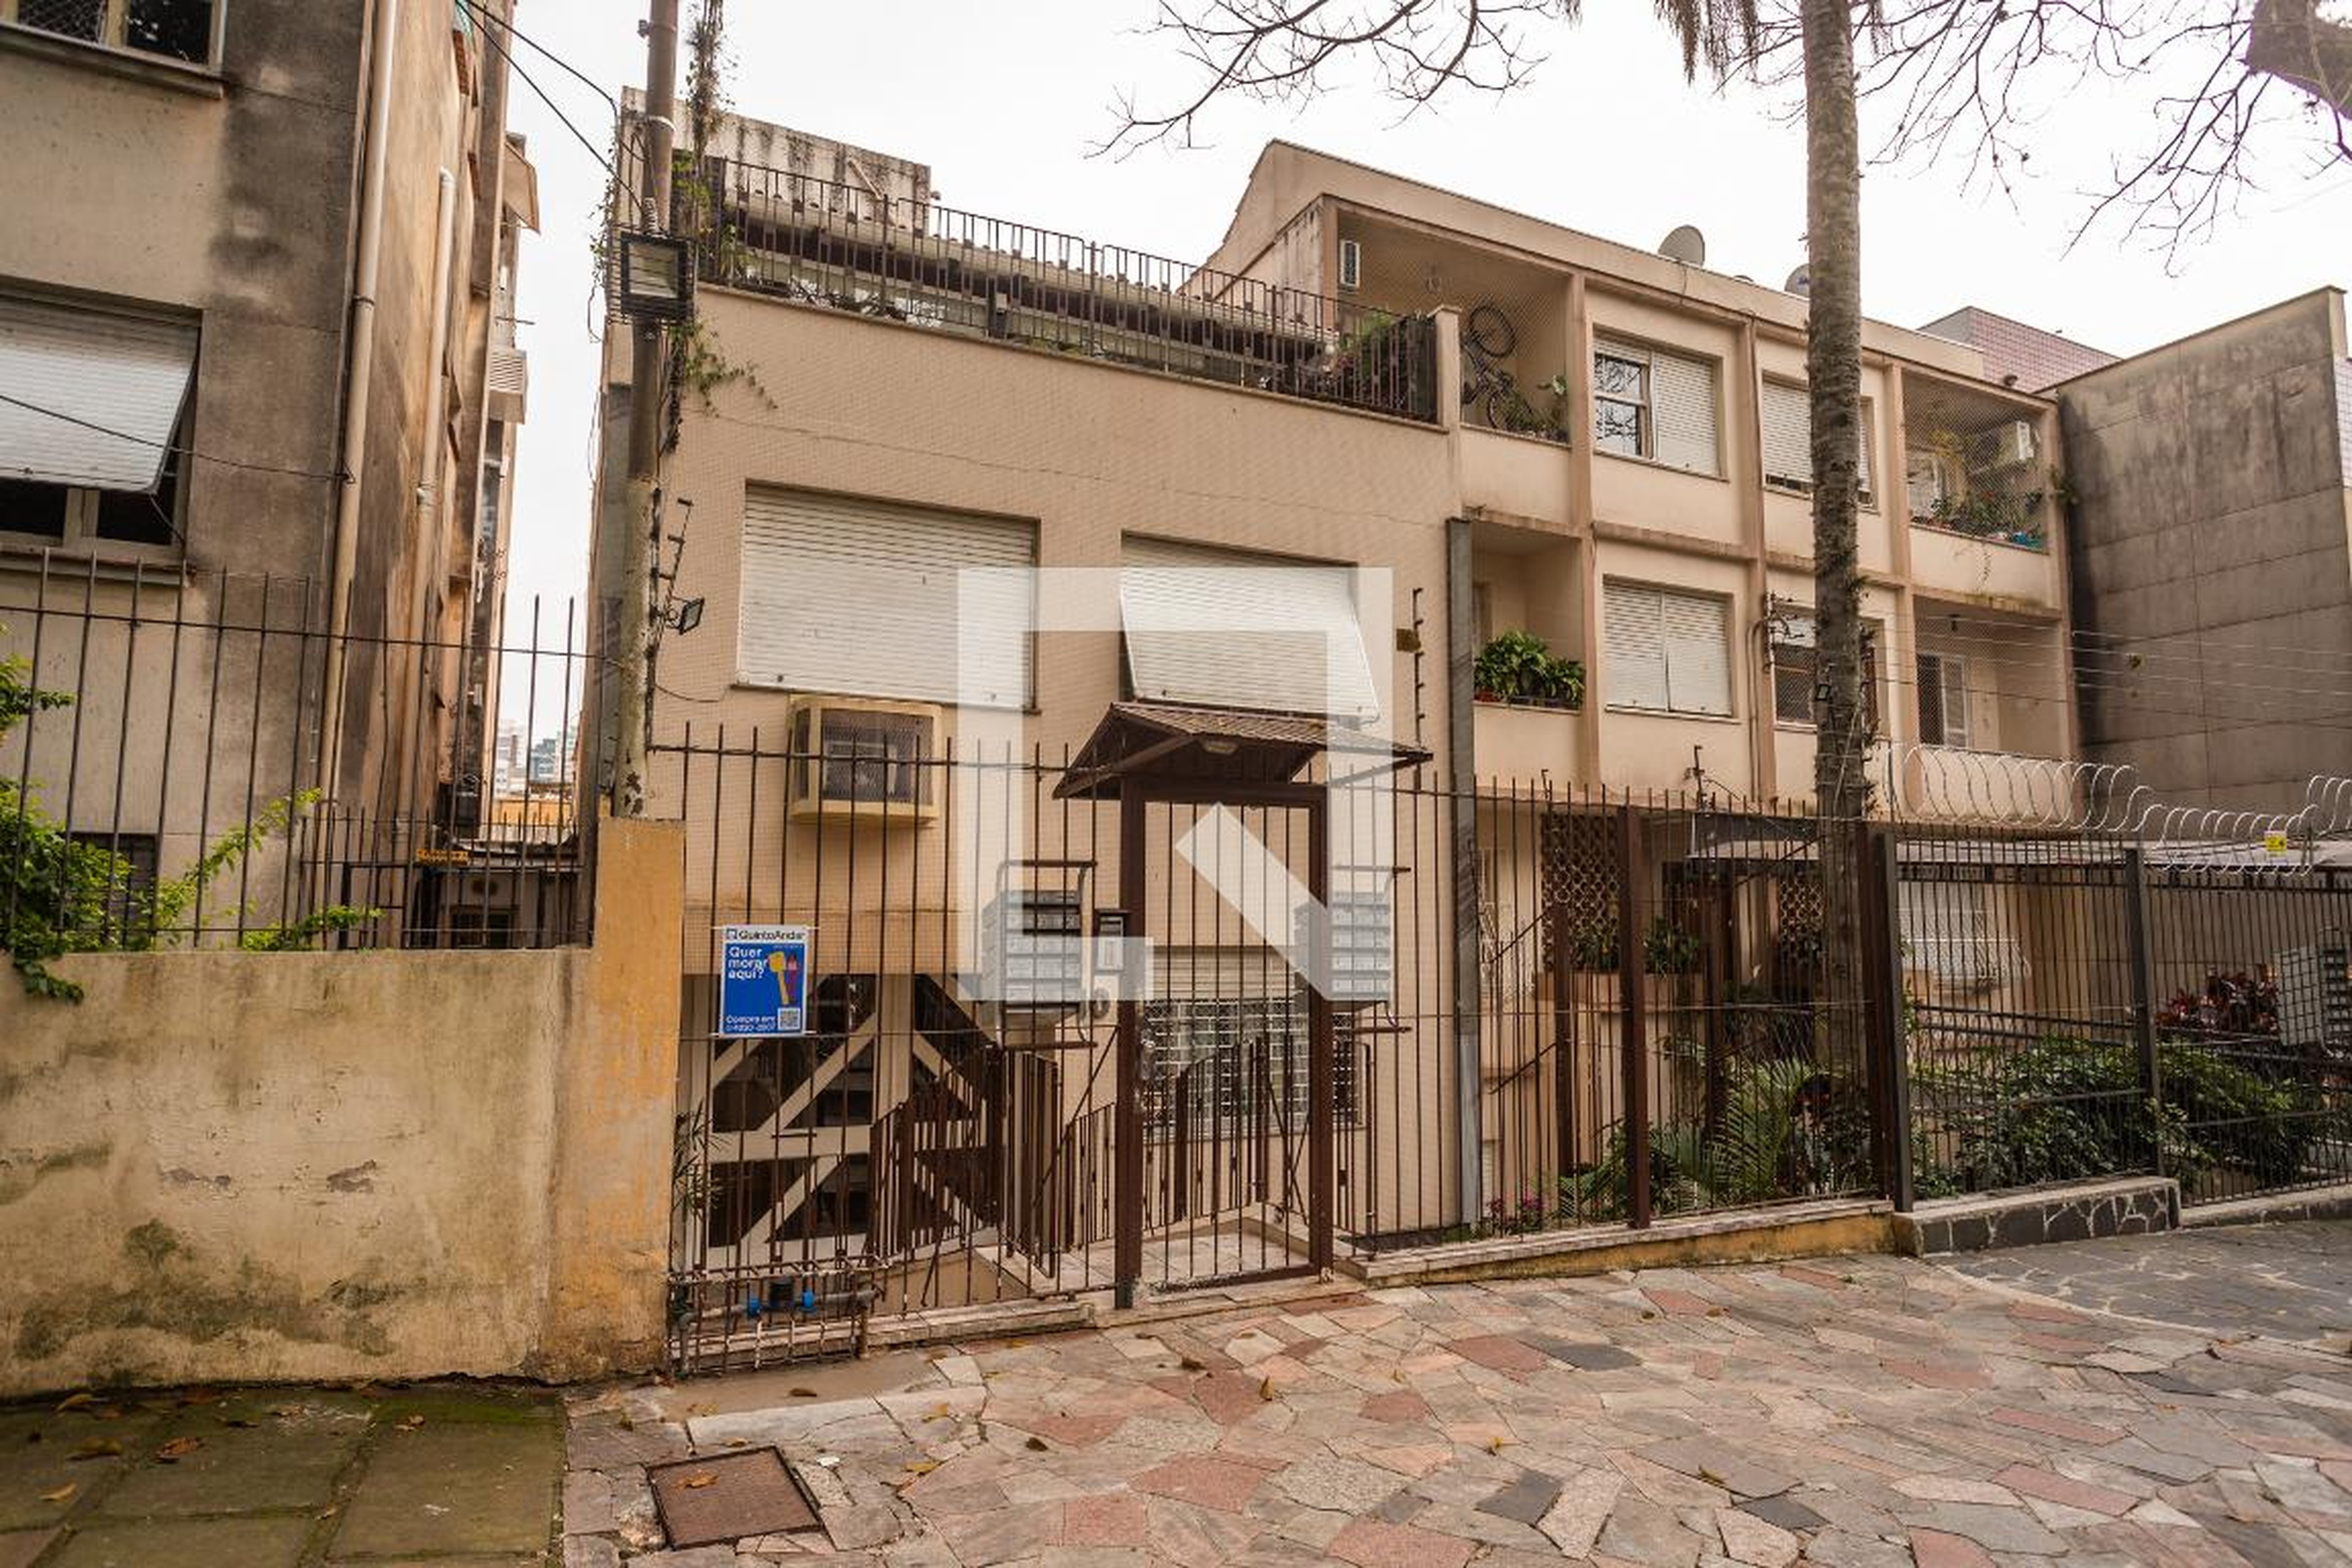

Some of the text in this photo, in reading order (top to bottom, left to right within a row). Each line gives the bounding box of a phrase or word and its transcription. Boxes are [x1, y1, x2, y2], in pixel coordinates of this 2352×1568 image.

[728, 947, 763, 957] Quer
[728, 959, 767, 968] morar
[728, 968, 764, 980] aqui?
